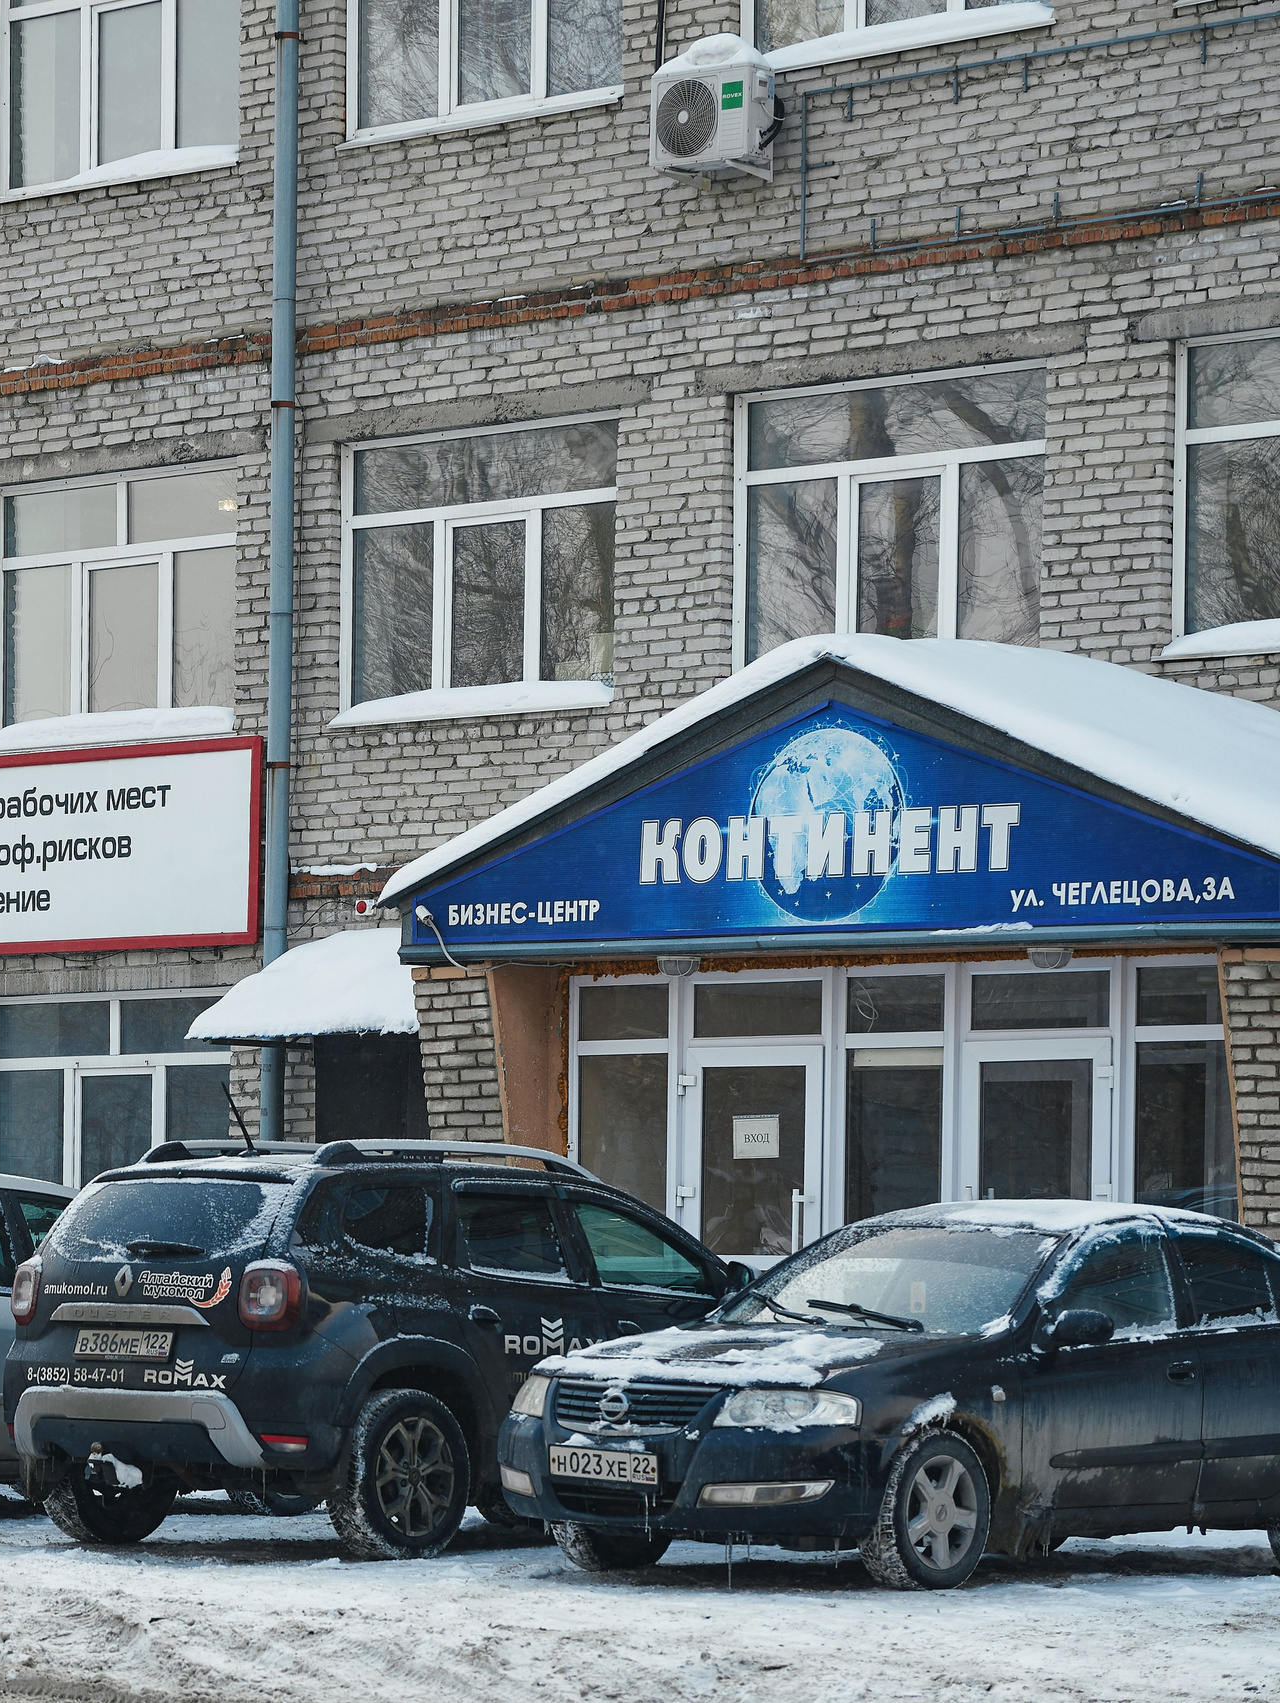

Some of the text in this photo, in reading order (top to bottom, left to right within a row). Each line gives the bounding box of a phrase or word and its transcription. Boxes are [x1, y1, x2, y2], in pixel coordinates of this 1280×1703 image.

[106, 784, 172, 812] мест
[639, 803, 1021, 885] КОНТИНЕНТ
[1010, 889, 1045, 912] ул.
[448, 900, 600, 926] БИЗНЕС-ЦЕНТР
[744, 1133, 770, 1144] ВХОД
[138, 1270, 214, 1288] Алтайский
[44, 1282, 108, 1297] amukomol.ru
[143, 1282, 206, 1300] мукомол
[74, 1308, 171, 1321] DUSTER
[79, 1332, 169, 1355] В386МЕ 122
[27, 1366, 126, 1385] 8-(3852) 58-47-01
[143, 1367, 227, 1389] ROMAX
[557, 1451, 651, 1479] Н023ХЕ 22
[632, 1473, 646, 1481] RUS
